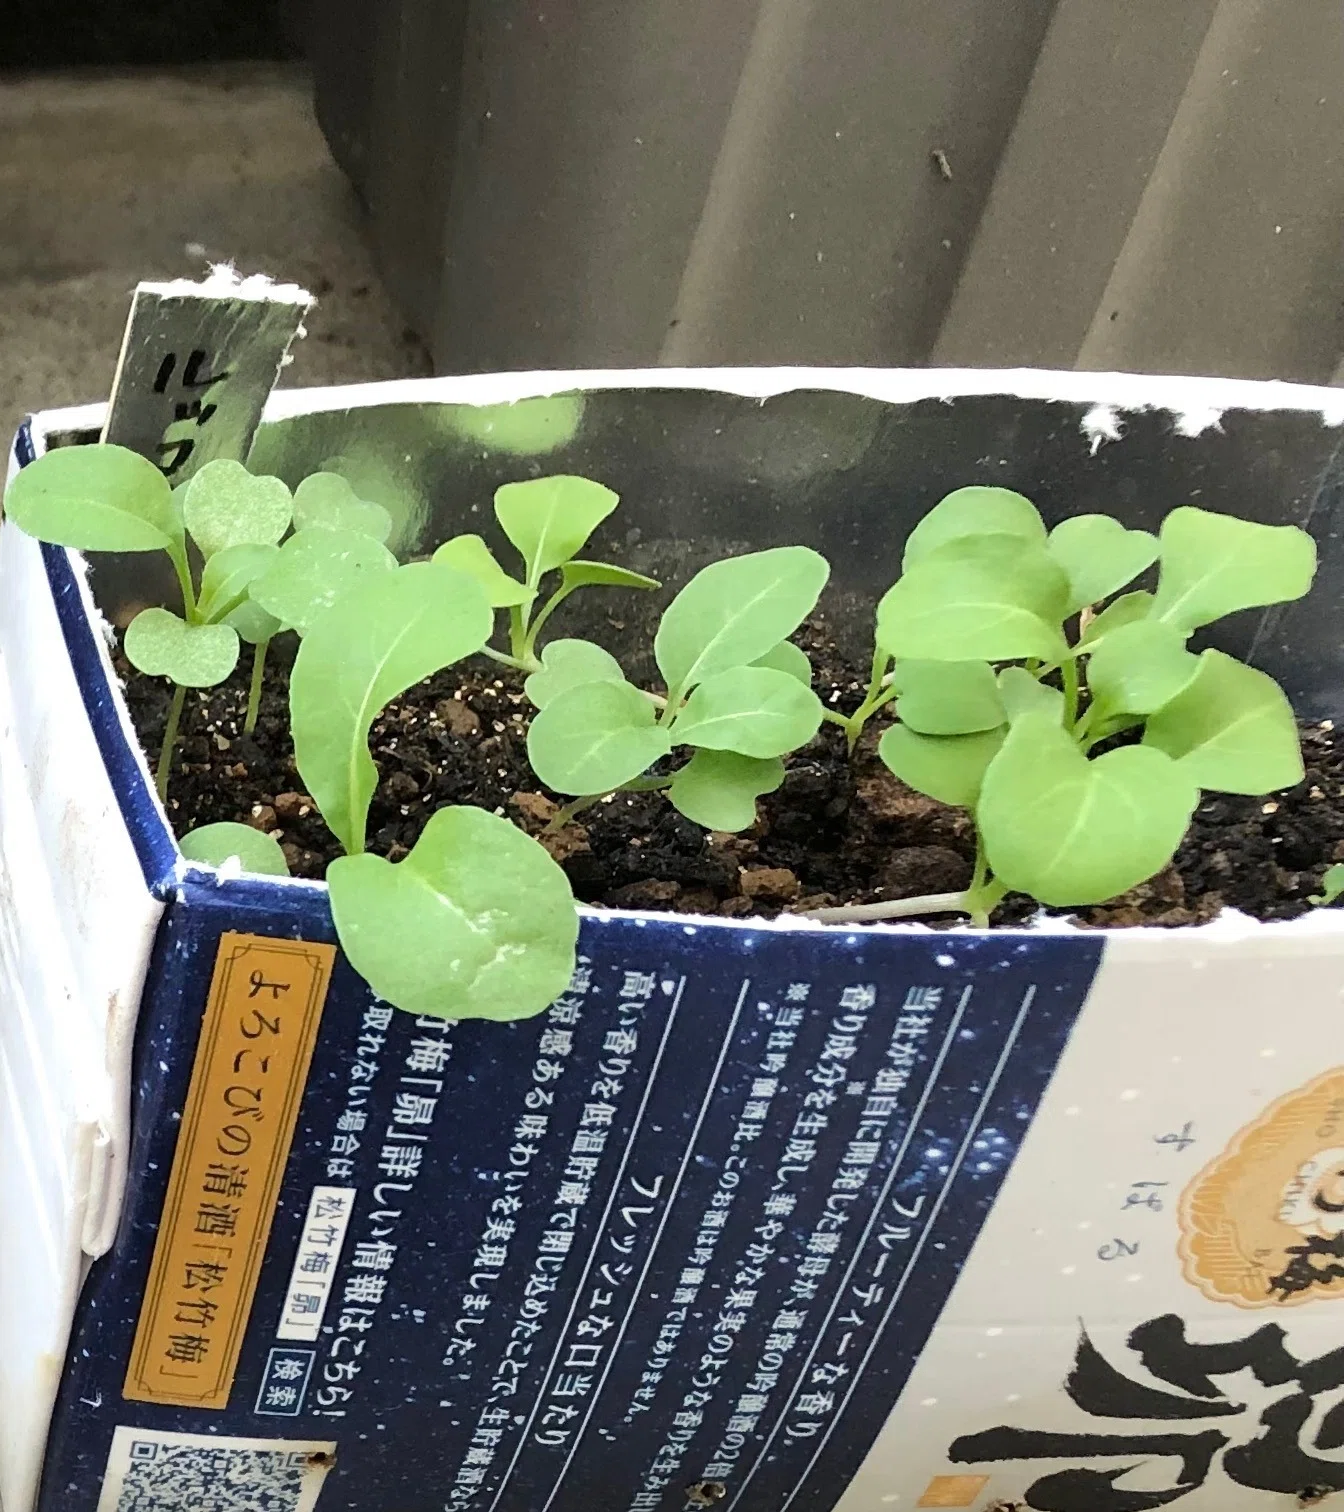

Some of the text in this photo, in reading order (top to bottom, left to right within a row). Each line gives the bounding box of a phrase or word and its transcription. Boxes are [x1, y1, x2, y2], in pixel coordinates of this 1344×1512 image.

[160, 968, 291, 1379] よろこびの清酒「松竹梅」
[326, 988, 394, 1179] 取れない場合は
[285, 1196, 347, 1327] 松竹梅「昴」
[535, 1175, 664, 1445] フレッシュな口当たり
[786, 1195, 927, 1437] フルーティーな香り
[264, 1357, 305, 1407] 検索
